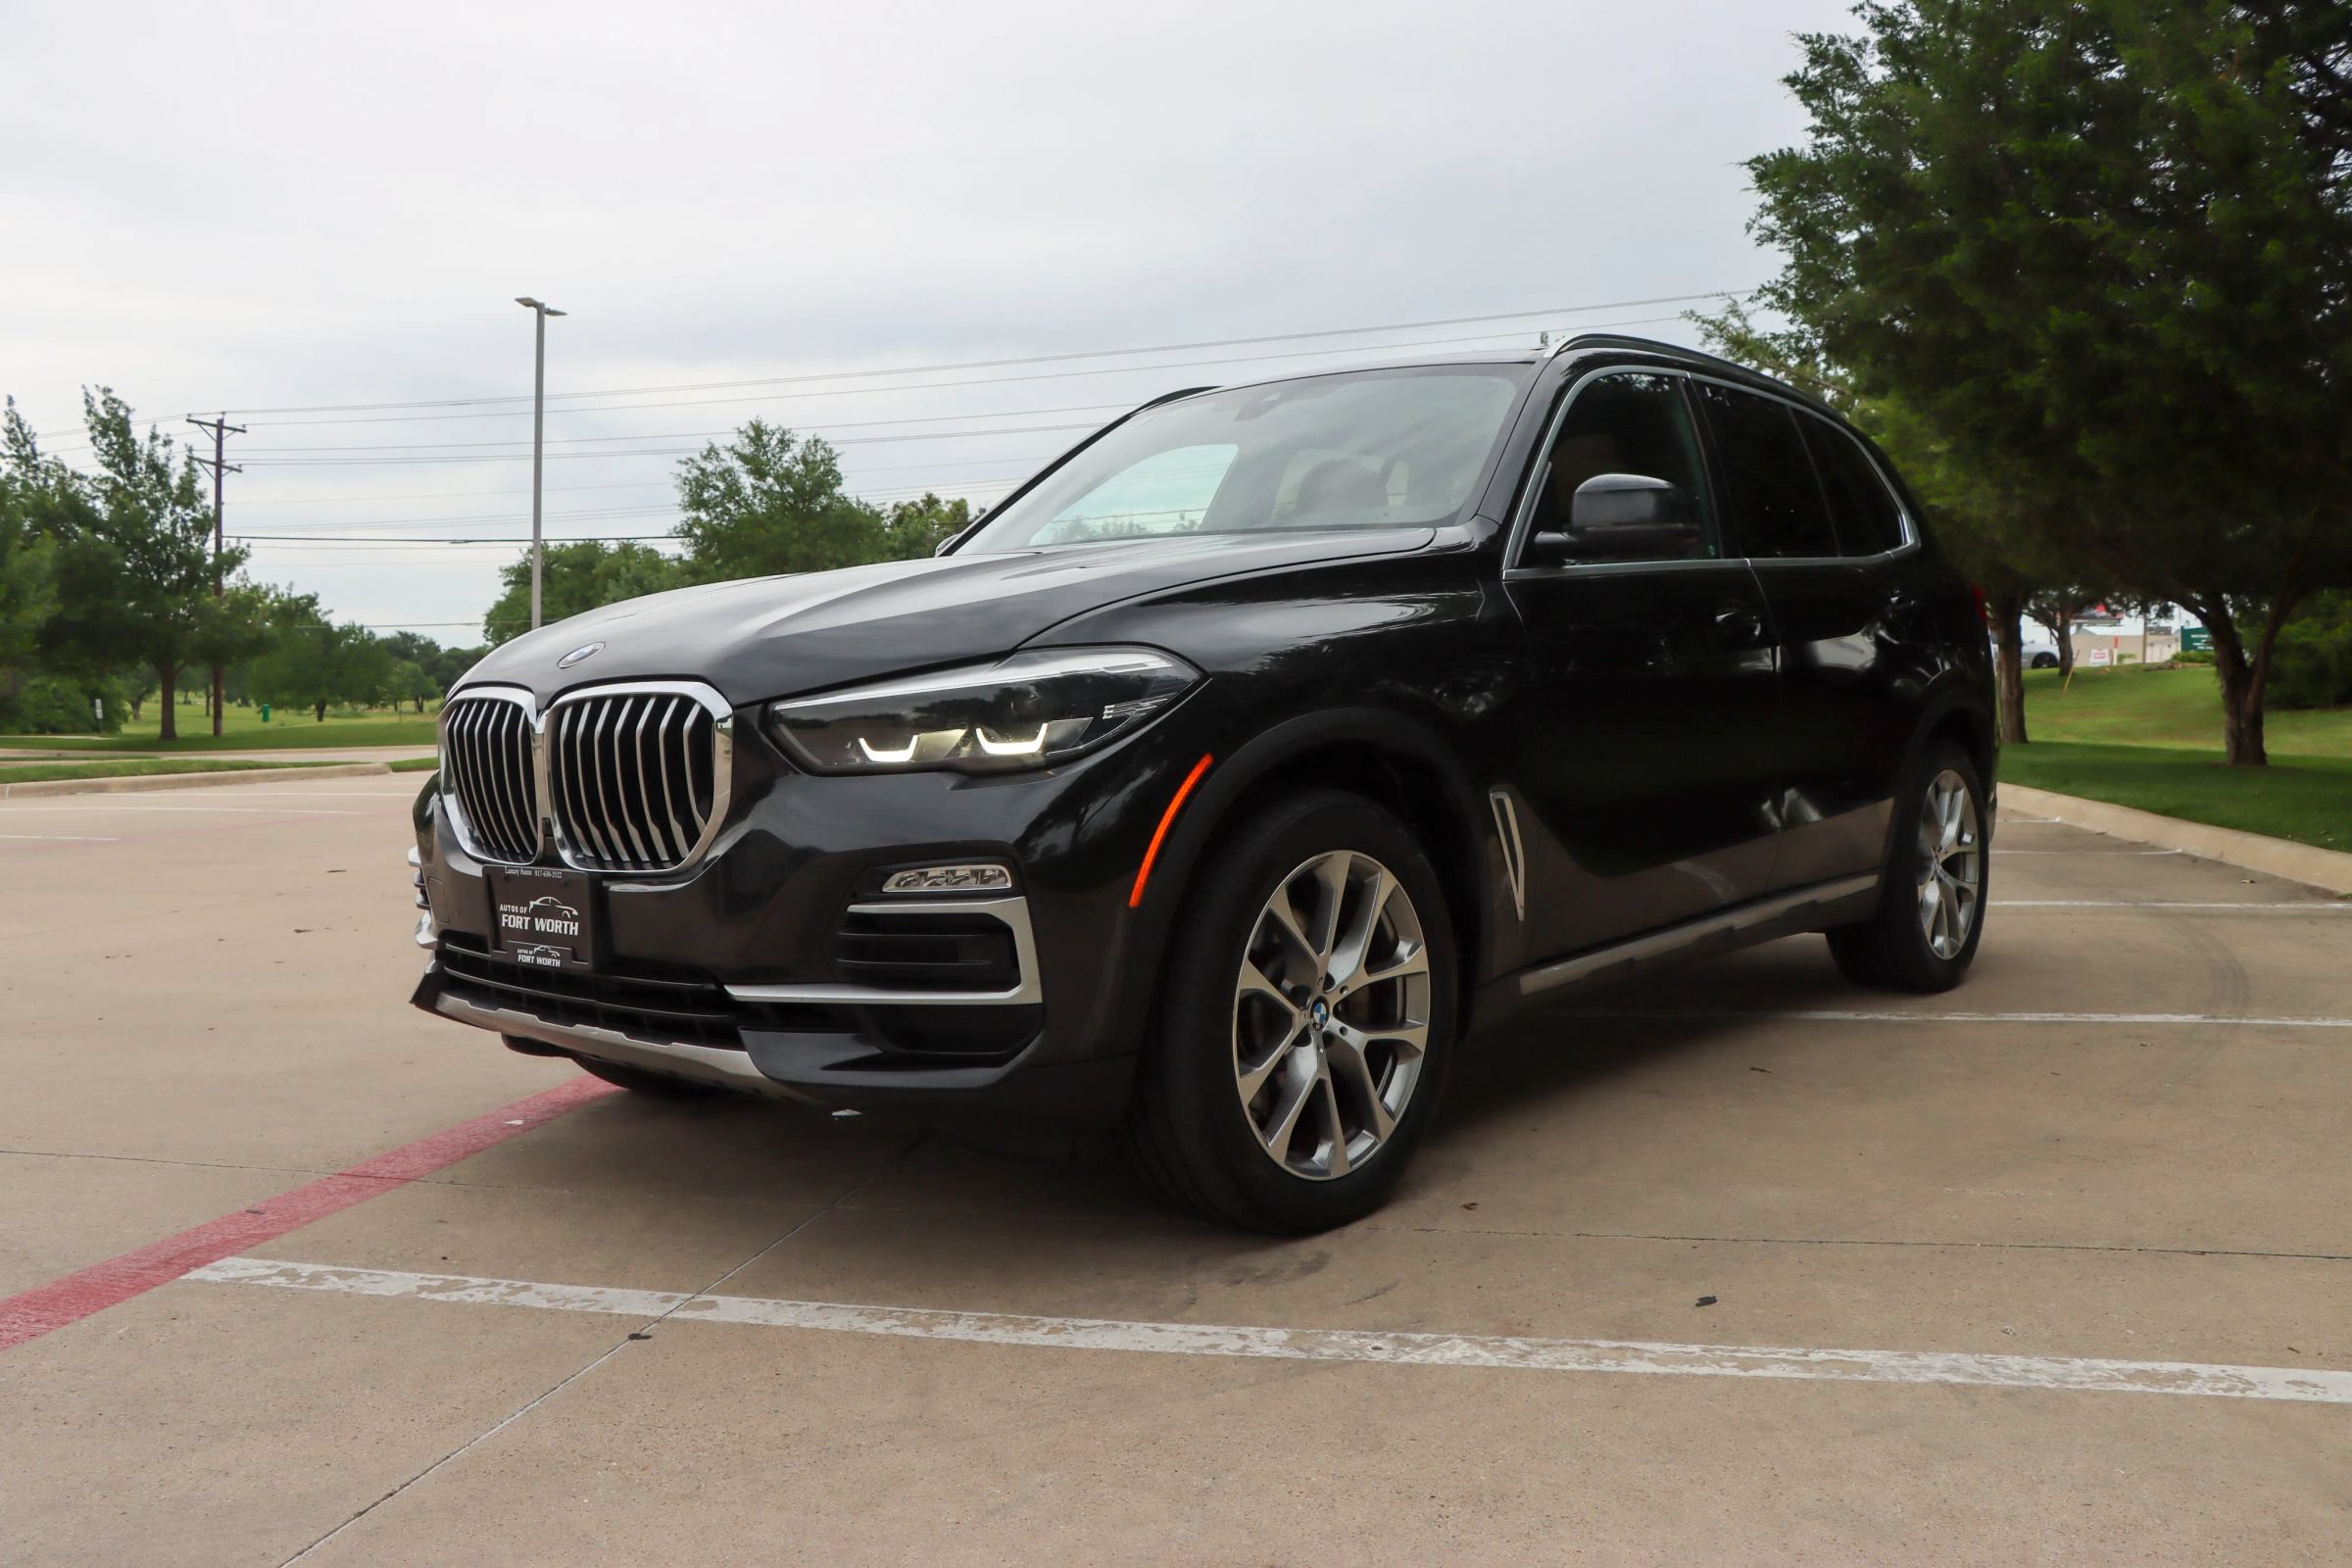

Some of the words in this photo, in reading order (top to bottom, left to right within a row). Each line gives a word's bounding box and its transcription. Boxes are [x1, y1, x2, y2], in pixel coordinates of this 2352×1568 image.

[500, 904, 518, 913] AUTOS
[502, 913, 531, 930] FORT
[534, 917, 579, 936] WORTH
[517, 955, 535, 963] FORT
[536, 956, 561, 967] WORTH
